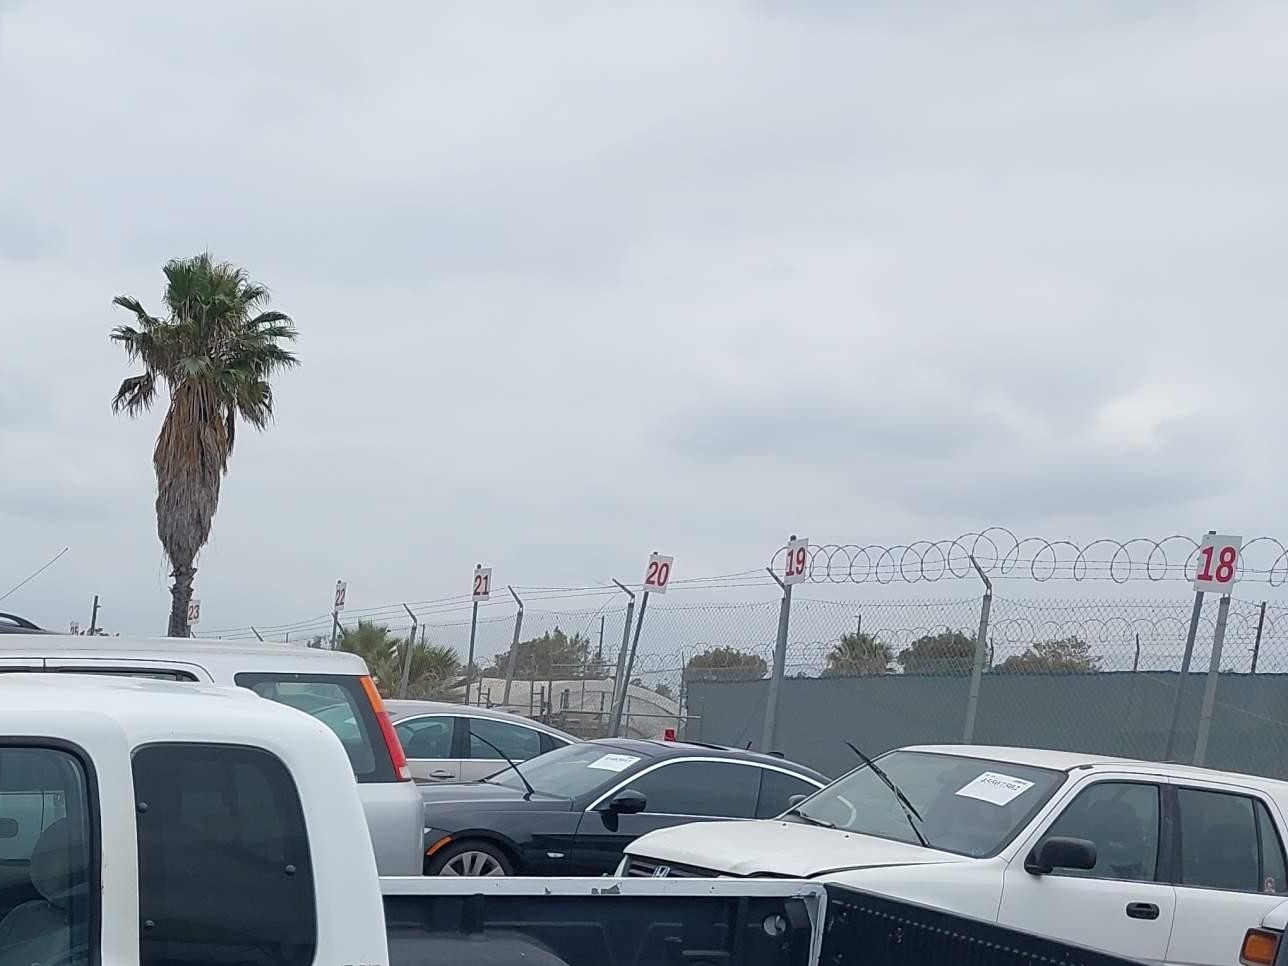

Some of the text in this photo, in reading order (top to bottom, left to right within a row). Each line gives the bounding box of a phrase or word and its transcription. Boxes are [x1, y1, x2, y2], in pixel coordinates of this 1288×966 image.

[786, 547, 805, 576] 19
[1197, 546, 1236, 583] 18
[473, 574, 489, 596] 21
[645, 561, 670, 587] 20
[335, 588, 346, 606] 22
[187, 604, 200, 620] 23
